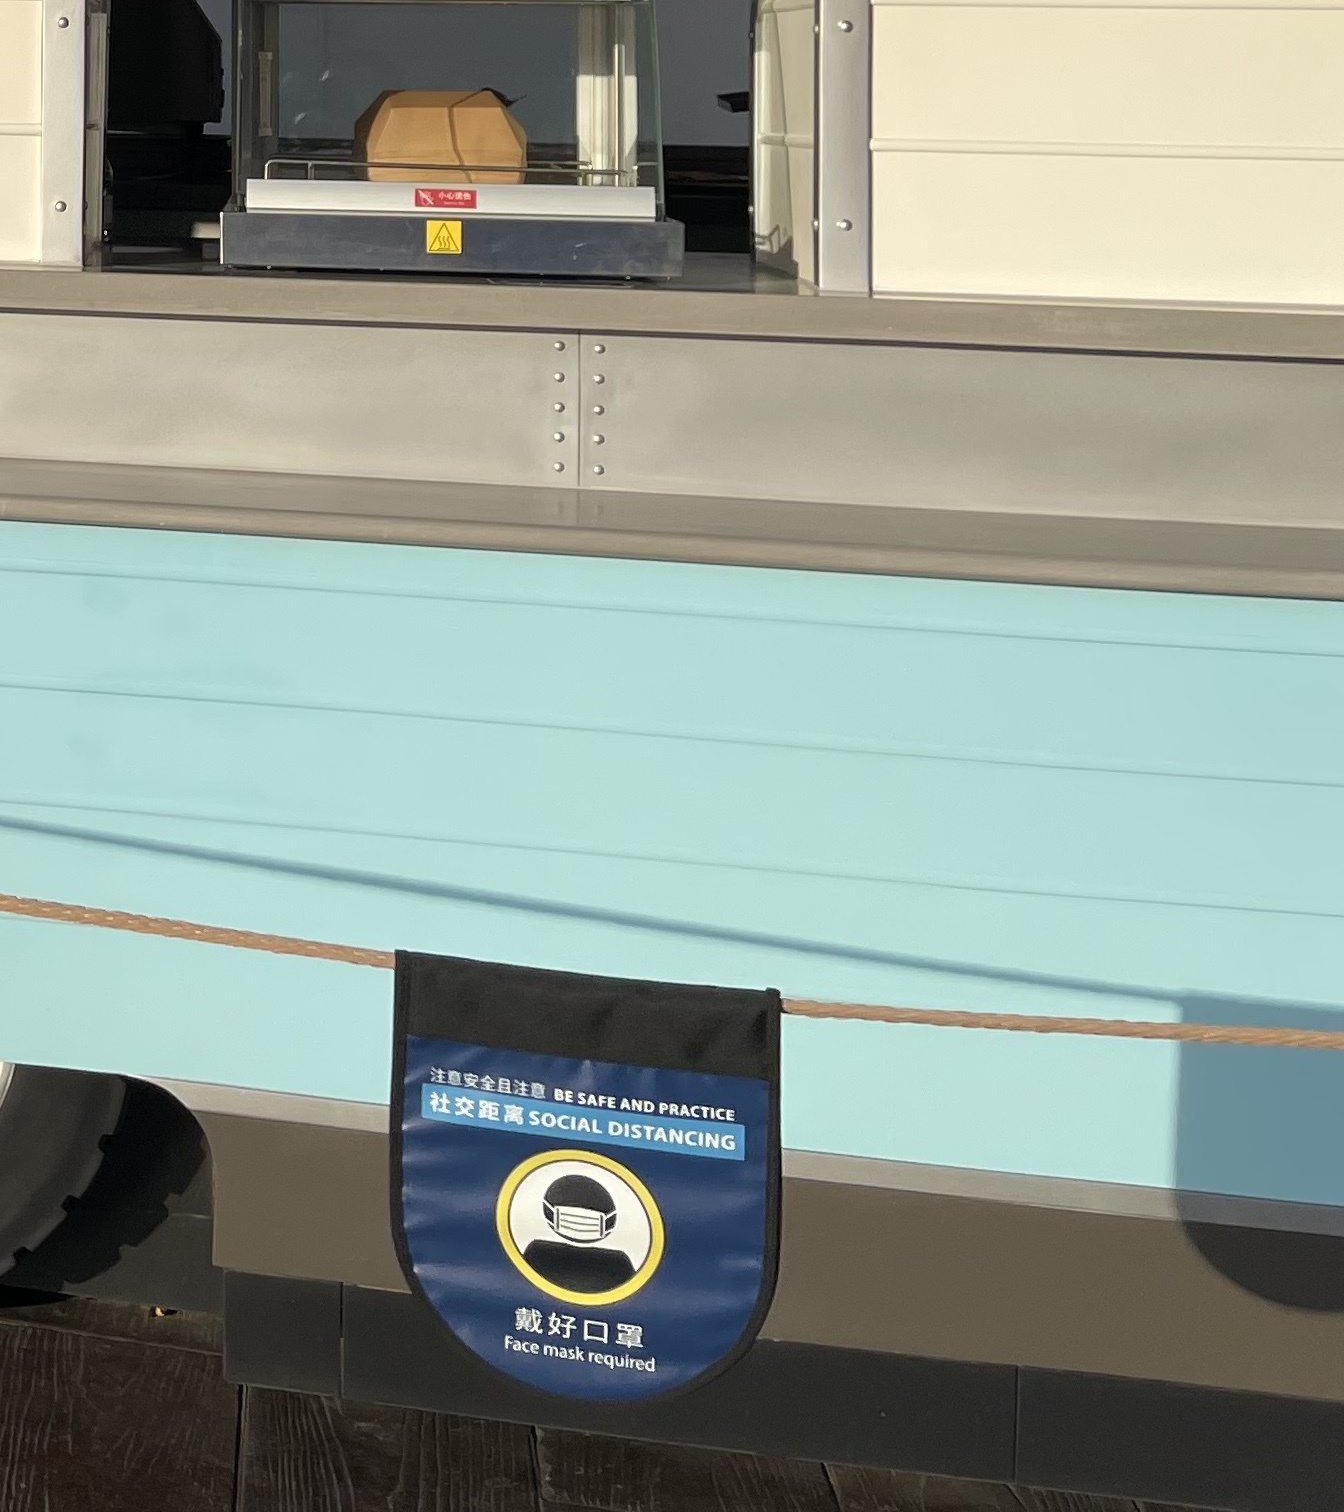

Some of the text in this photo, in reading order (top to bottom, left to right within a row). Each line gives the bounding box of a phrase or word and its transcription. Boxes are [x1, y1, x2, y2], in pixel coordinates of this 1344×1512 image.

[430, 1066, 736, 1122] 注意安全且注意 BE SAFE AND PRACTICE
[429, 1090, 736, 1151] 社交距离 SOCIAL DISTANCING
[515, 1307, 644, 1348] 戴好口罩
[504, 1334, 656, 1372] Face mask required
